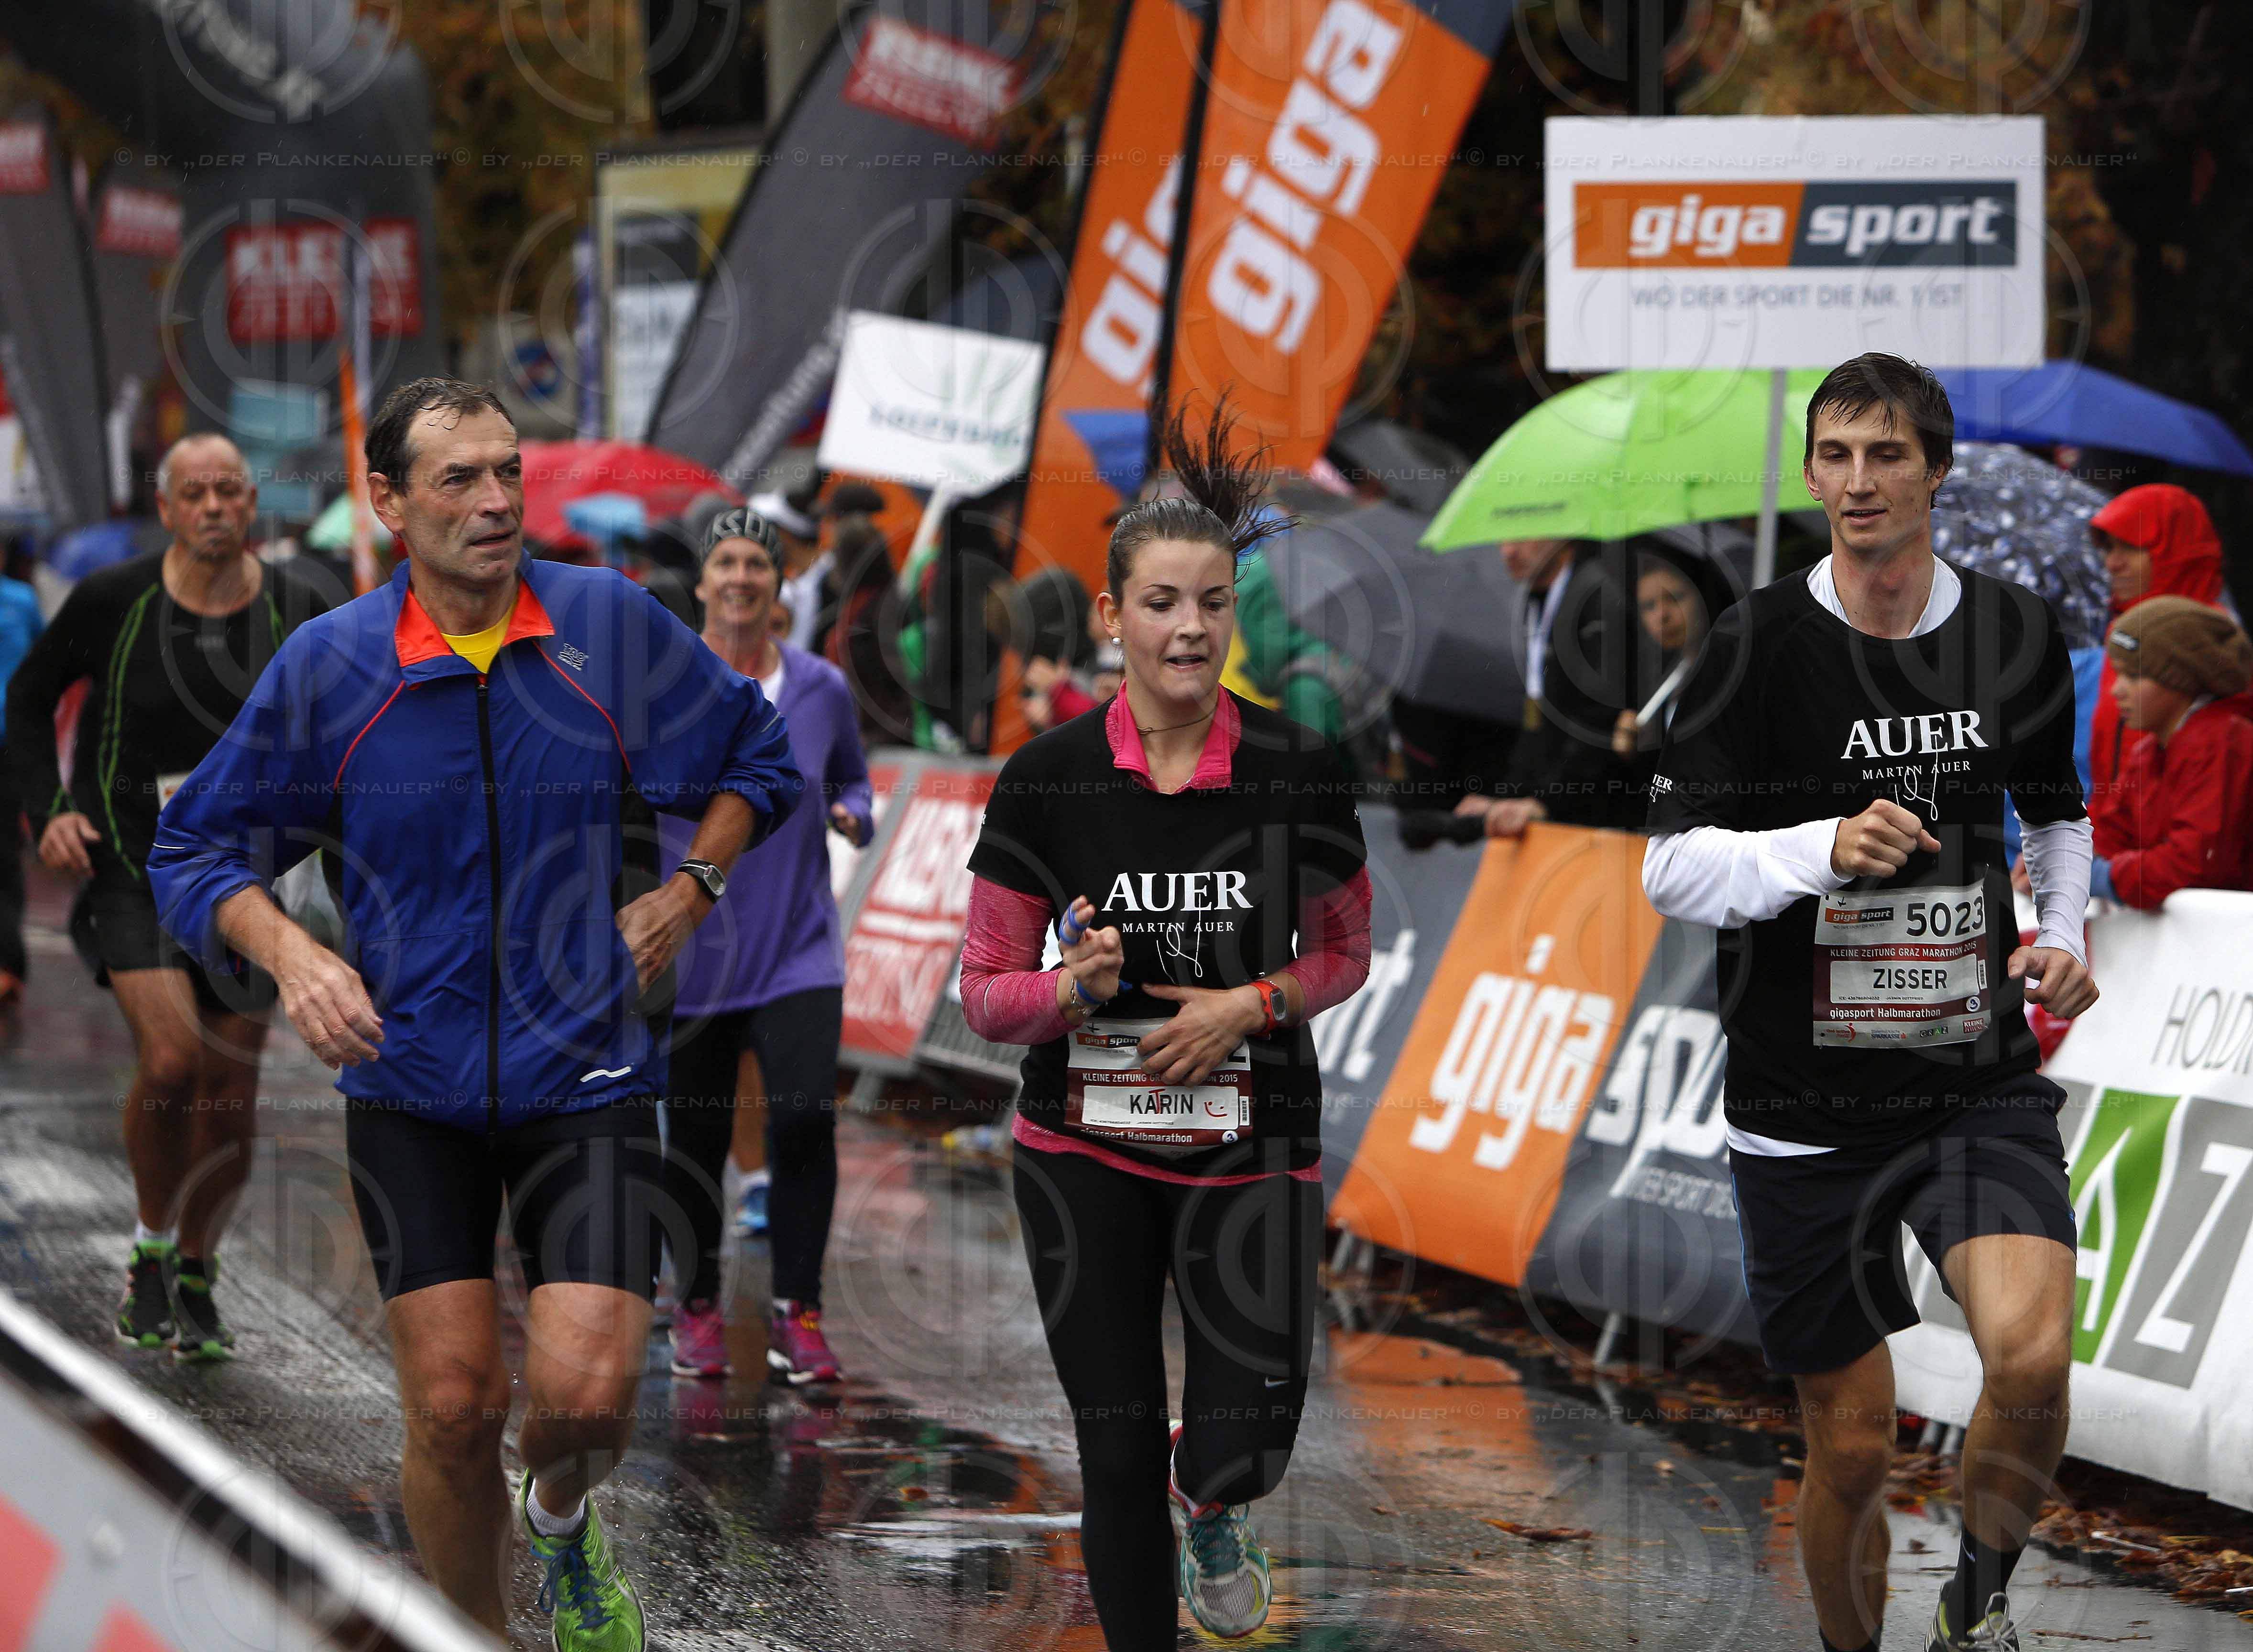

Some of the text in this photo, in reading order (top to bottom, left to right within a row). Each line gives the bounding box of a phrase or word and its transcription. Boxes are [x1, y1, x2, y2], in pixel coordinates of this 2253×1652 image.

[1206, 0, 1403, 356] giga
[1628, 194, 2001, 259] giga sport
[1681, 285, 1728, 308] DER
[1733, 285, 1809, 308] SPORT
[1818, 285, 1853, 308] DIE
[1841, 710, 1989, 759] AUER
[1862, 761, 1970, 780] MARTIN AUER
[1101, 871, 1254, 911] AUER
[1833, 910, 1891, 922] giga sport
[1906, 896, 1984, 937] 5023
[1122, 922, 1234, 933] MARTIN AUER
[1830, 941, 1977, 957] KLEINE ZEITUNG GRAZ MARATHON 2015
[1873, 968, 1948, 989] ZISSER
[1830, 1008, 1941, 1019] gigasport Halbmarathon
[1410, 933, 1615, 1171] giga
[1083, 1073, 1110, 1082] KLEINE
[1112, 1073, 1147, 1082] ZEITUNG
[1219, 1075, 1238, 1083] 2015
[1127, 1131, 1193, 1143] Halbmarathon
